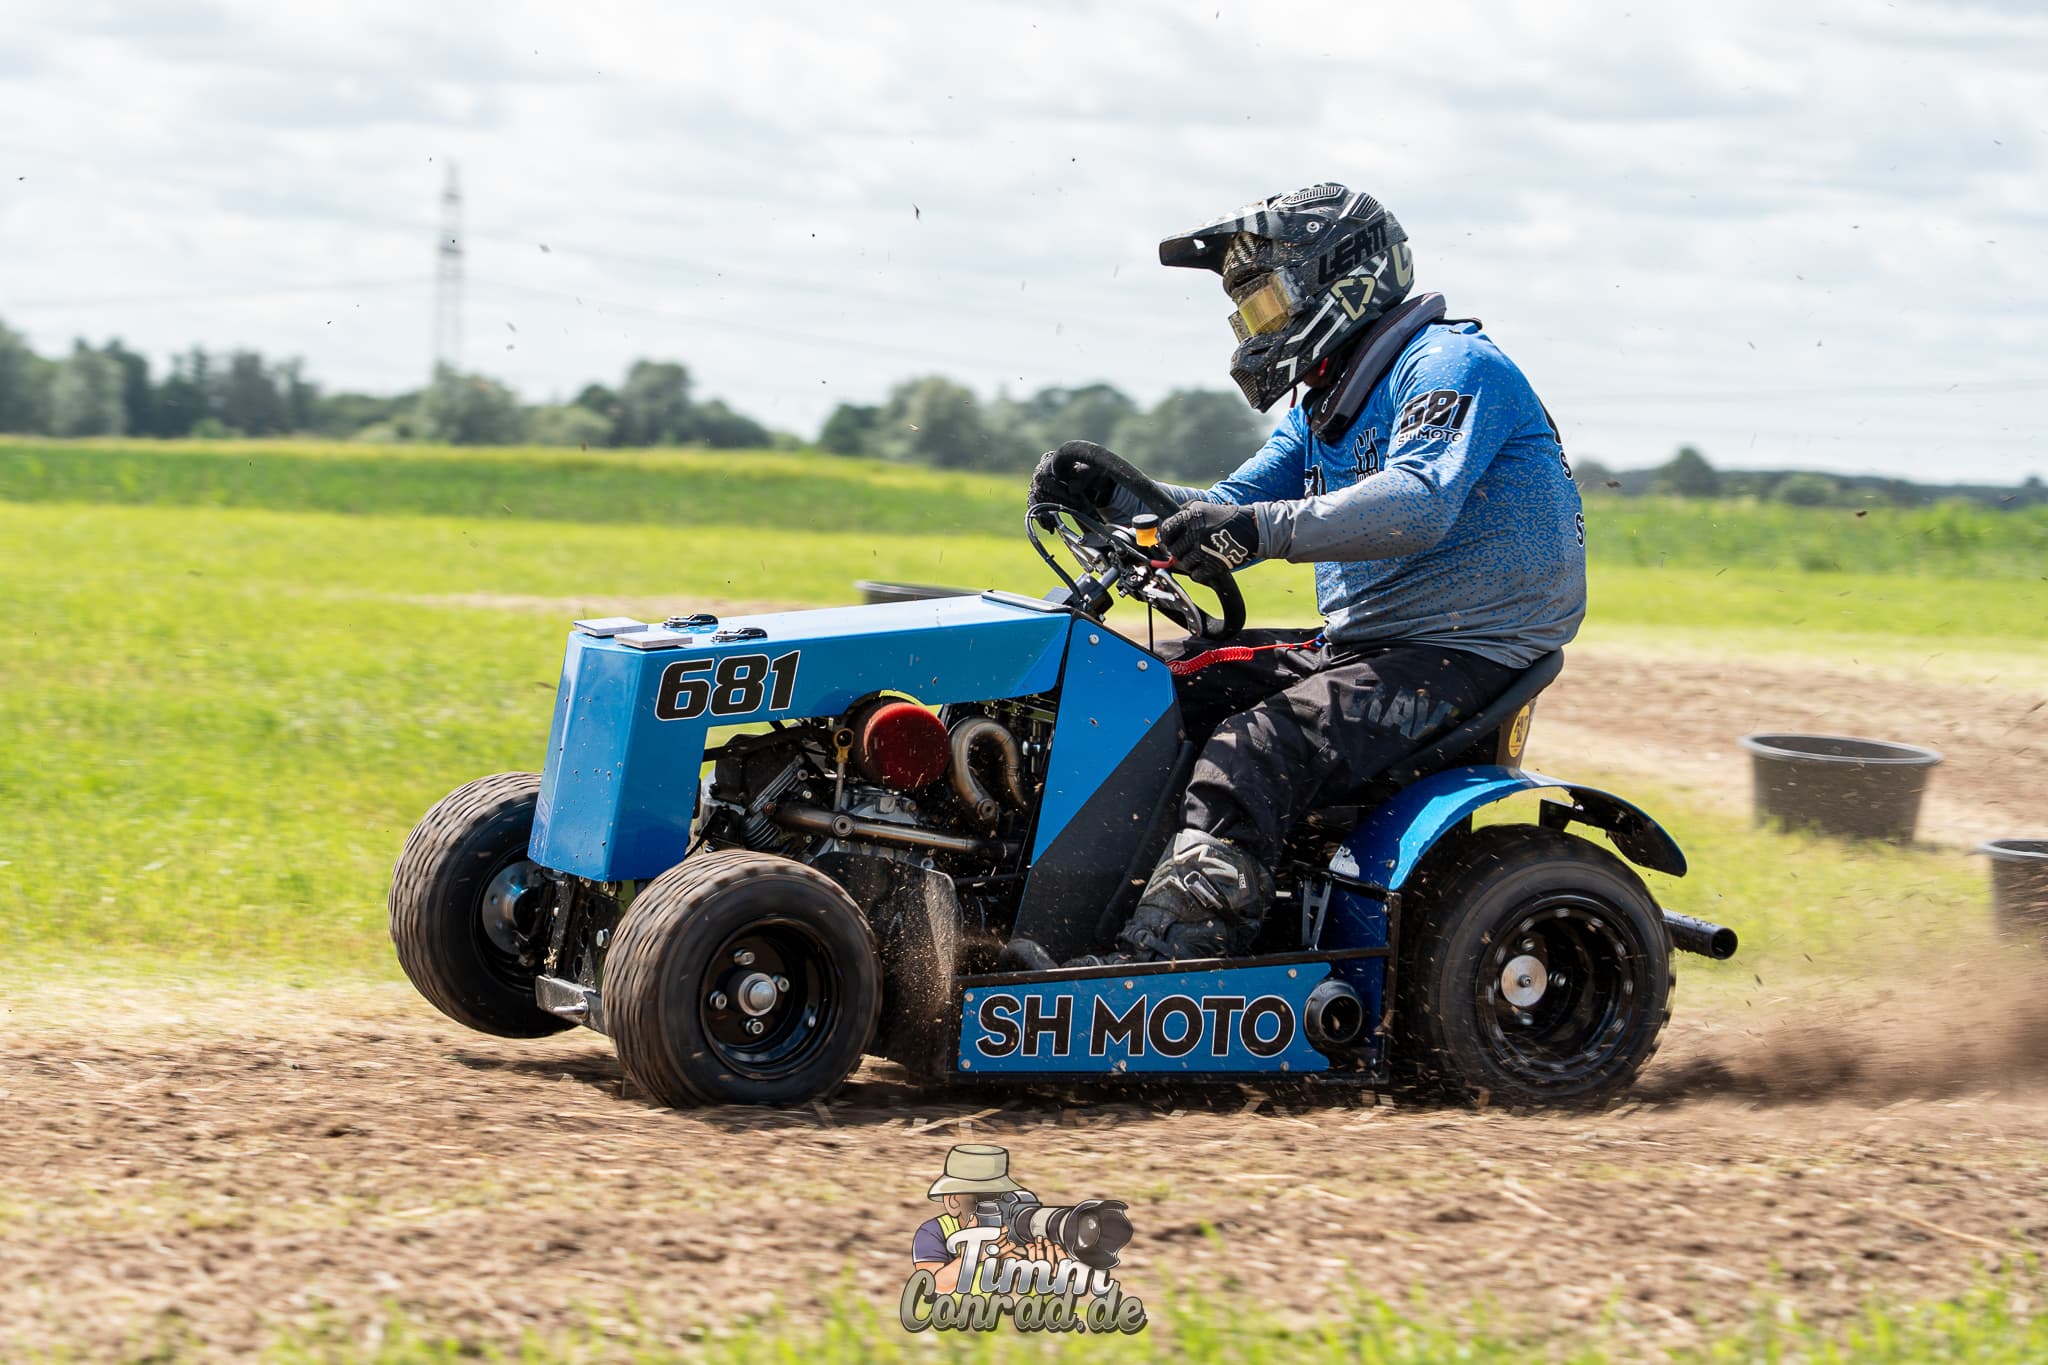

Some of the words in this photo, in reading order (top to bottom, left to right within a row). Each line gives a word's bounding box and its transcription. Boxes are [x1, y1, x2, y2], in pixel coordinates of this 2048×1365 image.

[1400, 389, 1474, 434] 681
[1416, 427, 1464, 444] MOTO
[655, 650, 801, 721] 681
[975, 993, 1074, 1058] SH
[1089, 993, 1296, 1058] MOTO
